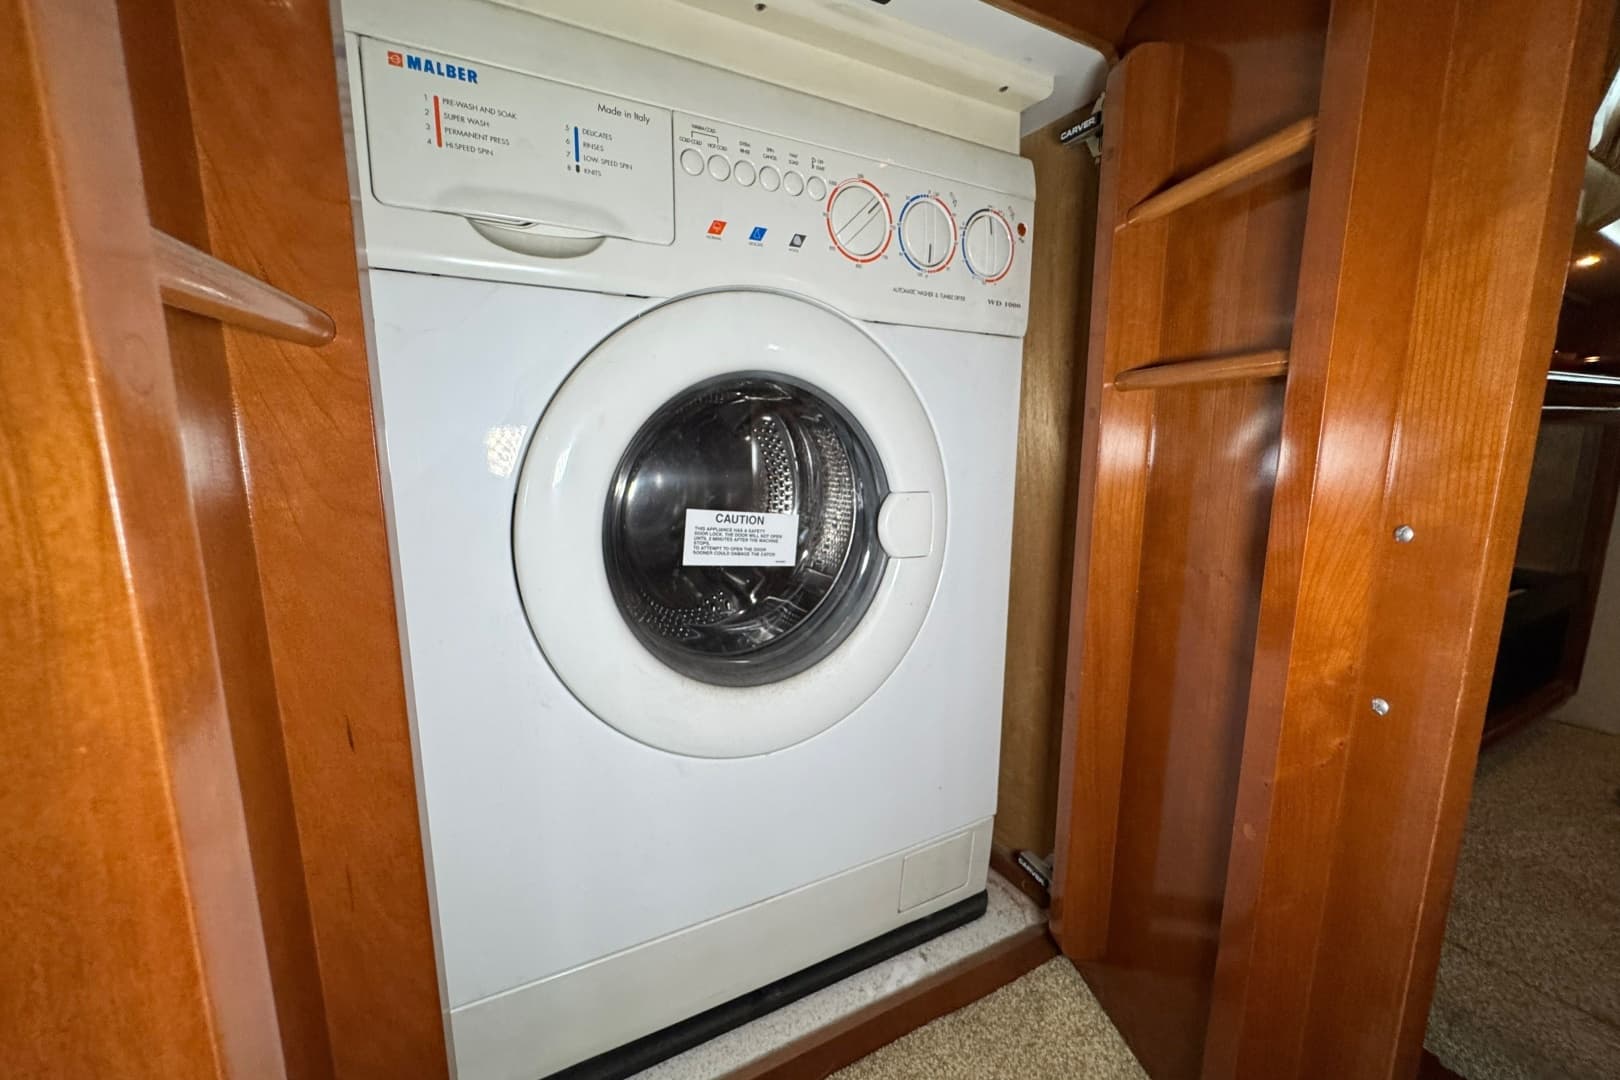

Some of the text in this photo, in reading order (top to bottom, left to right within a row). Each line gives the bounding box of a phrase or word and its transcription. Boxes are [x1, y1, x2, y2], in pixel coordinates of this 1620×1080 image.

[406, 54, 479, 84] MALBER
[424, 108, 490, 128] 2 SUPER WASH
[442, 97, 479, 111] PRE-WASH
[479, 105, 496, 115] AND
[497, 109, 518, 120] SOAK
[597, 103, 651, 125] Made in Italy
[444, 126, 489, 141] PERMANENT
[489, 135, 510, 146] PRESS
[582, 127, 613, 141] DELICATES
[1060, 116, 1096, 141] CARVER
[426, 137, 432, 145] 4
[477, 146, 494, 157] SPIN
[583, 154, 599, 164] LOW
[987, 298, 1002, 307] WD
[715, 513, 765, 525] CAUTION
